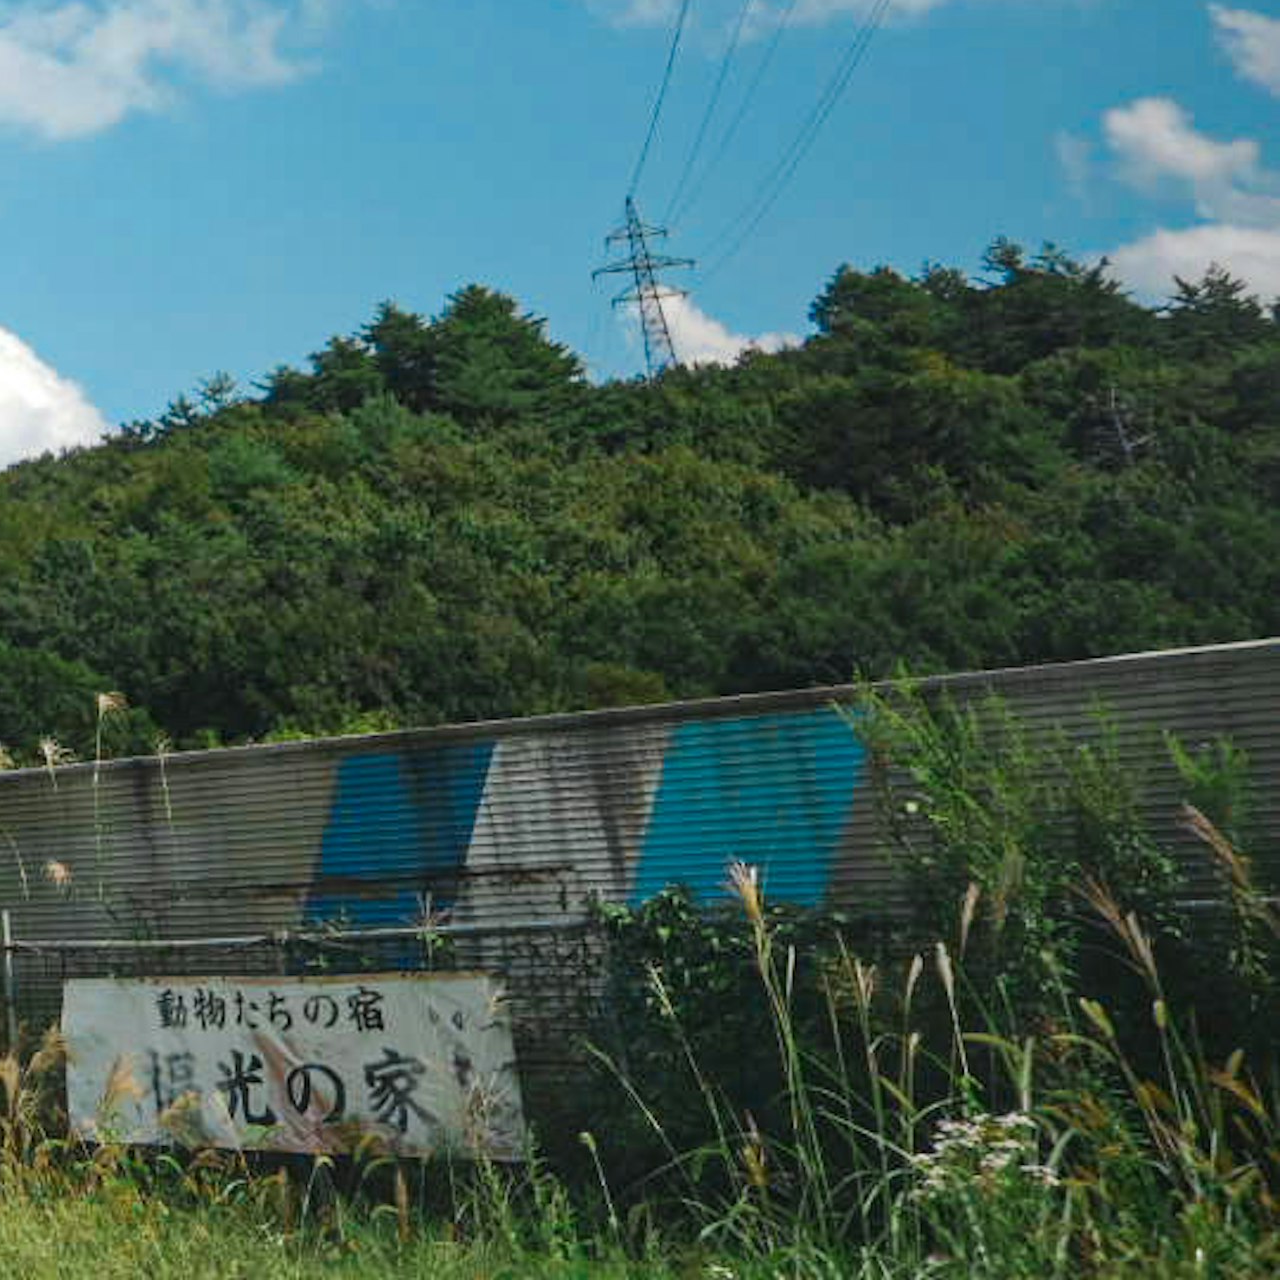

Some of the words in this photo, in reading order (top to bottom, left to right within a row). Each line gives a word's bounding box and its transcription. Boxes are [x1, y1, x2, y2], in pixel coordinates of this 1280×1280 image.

[156, 986, 386, 1033] 動物たちの宿
